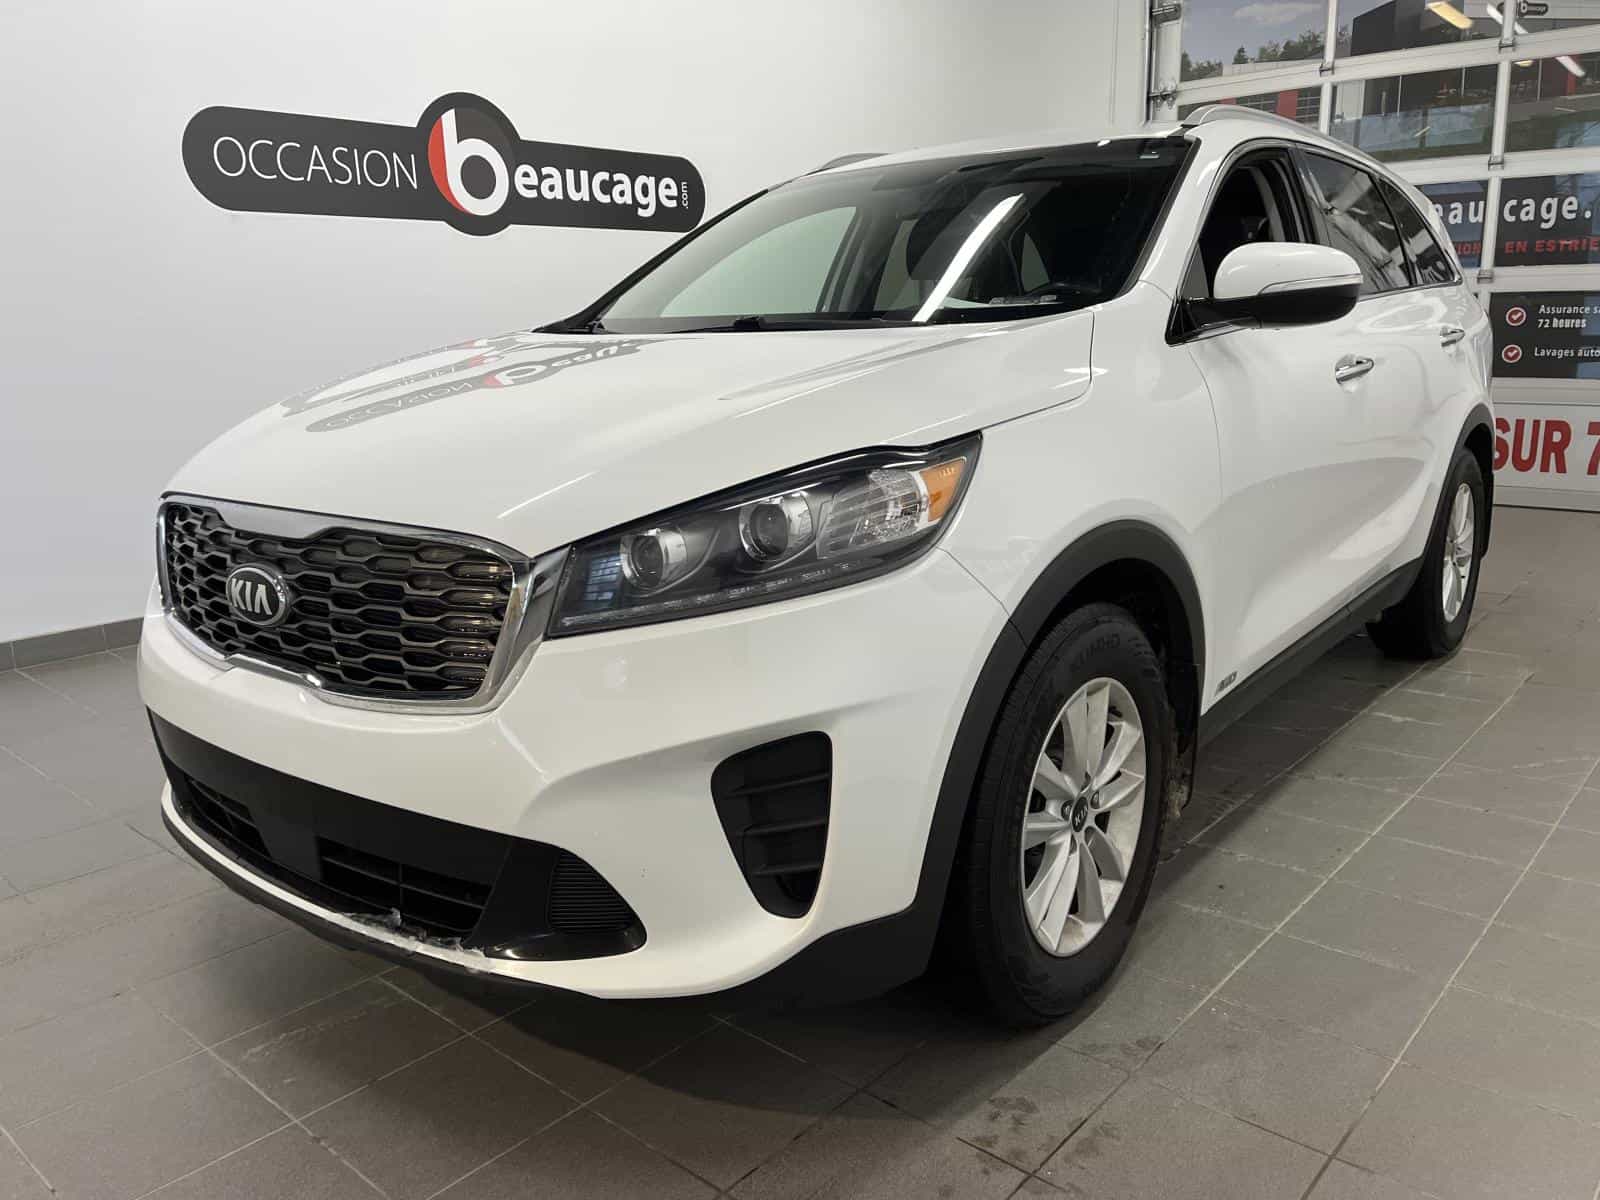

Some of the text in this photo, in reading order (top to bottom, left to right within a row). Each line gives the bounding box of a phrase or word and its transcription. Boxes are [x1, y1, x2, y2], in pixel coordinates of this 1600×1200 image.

[213, 136, 418, 190] OCCASION
[1456, 241, 1482, 256] ION
[1505, 240, 1529, 254] EN
[1538, 304, 1591, 314] Assurance
[1537, 318, 1550, 328] 72
[1534, 346, 1575, 359] Lavages
[1494, 417, 1572, 474] SUR
[231, 578, 273, 615] KIA
